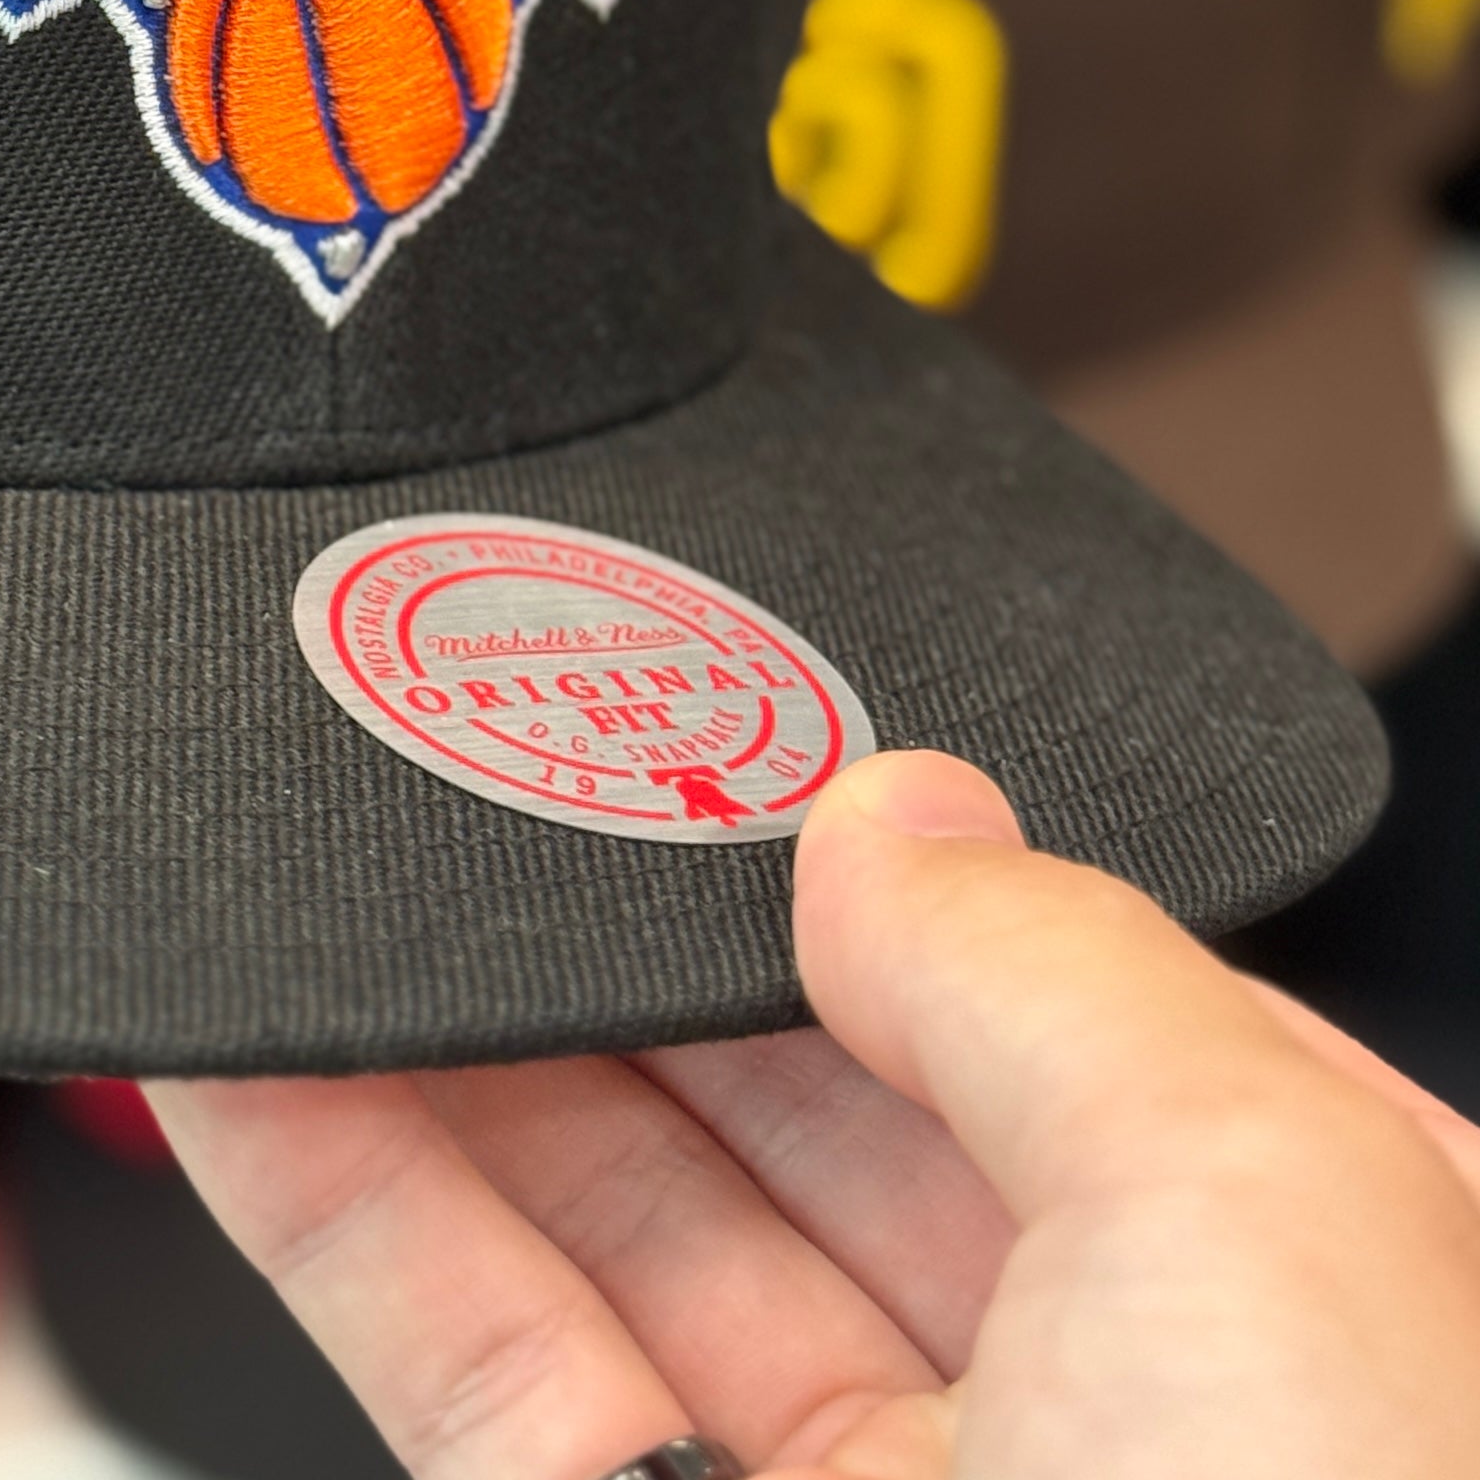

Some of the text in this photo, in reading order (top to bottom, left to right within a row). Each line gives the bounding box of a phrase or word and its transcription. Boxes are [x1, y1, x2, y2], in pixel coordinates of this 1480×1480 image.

[353, 574, 404, 681] NOSTALGIA
[392, 552, 444, 580] CO.
[423, 622, 686, 657] Mitchell & Ness
[404, 660, 797, 715] ORIGINAL
[527, 706, 744, 764] O.G. SNAPBACK
[577, 701, 680, 735] FIT
[538, 744, 813, 796] 19 04
